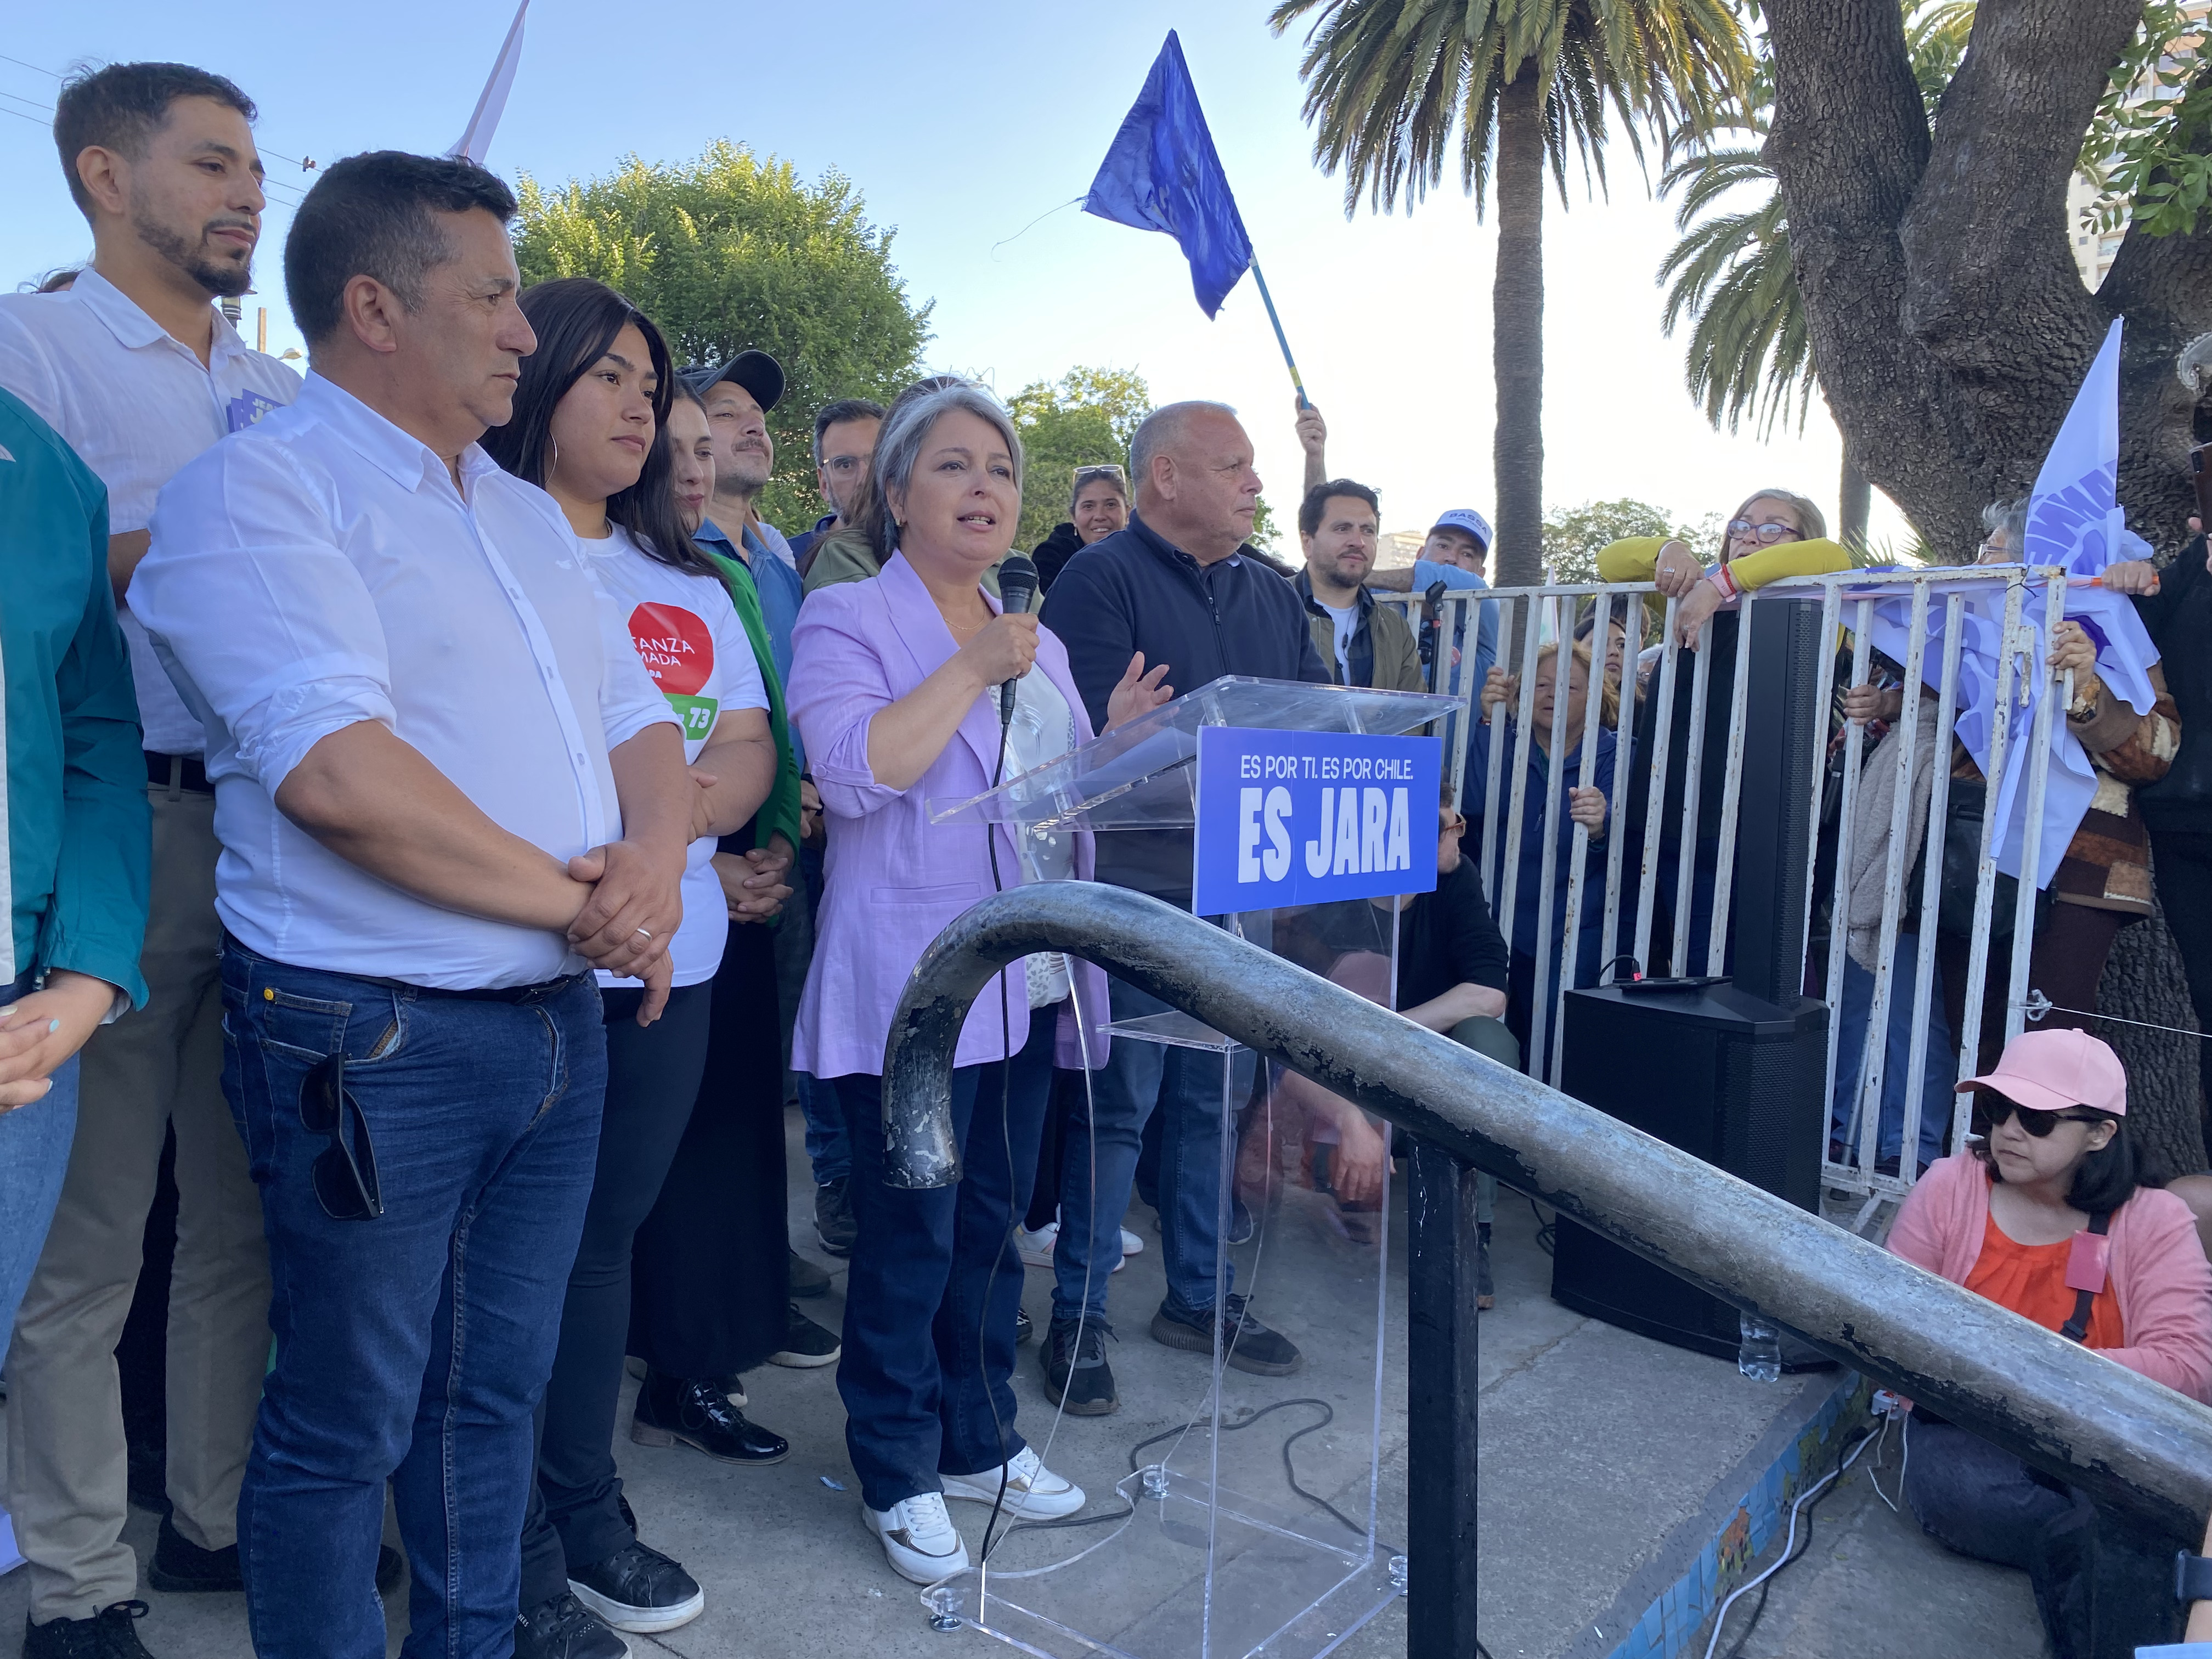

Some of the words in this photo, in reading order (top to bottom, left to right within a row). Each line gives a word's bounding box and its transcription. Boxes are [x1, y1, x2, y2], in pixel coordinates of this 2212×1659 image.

[1449, 513, 1487, 534] BASSA
[689, 707, 710, 729] 73
[1240, 754, 1261, 778] ES
[1265, 755, 1297, 779] POR
[1302, 756, 1318, 779] TI.
[1322, 757, 1339, 780] ES
[1343, 757, 1372, 780] POR
[1375, 758, 1413, 780] CHILE.
[1238, 786, 1293, 883] ES
[1305, 787, 1410, 879] JARA
